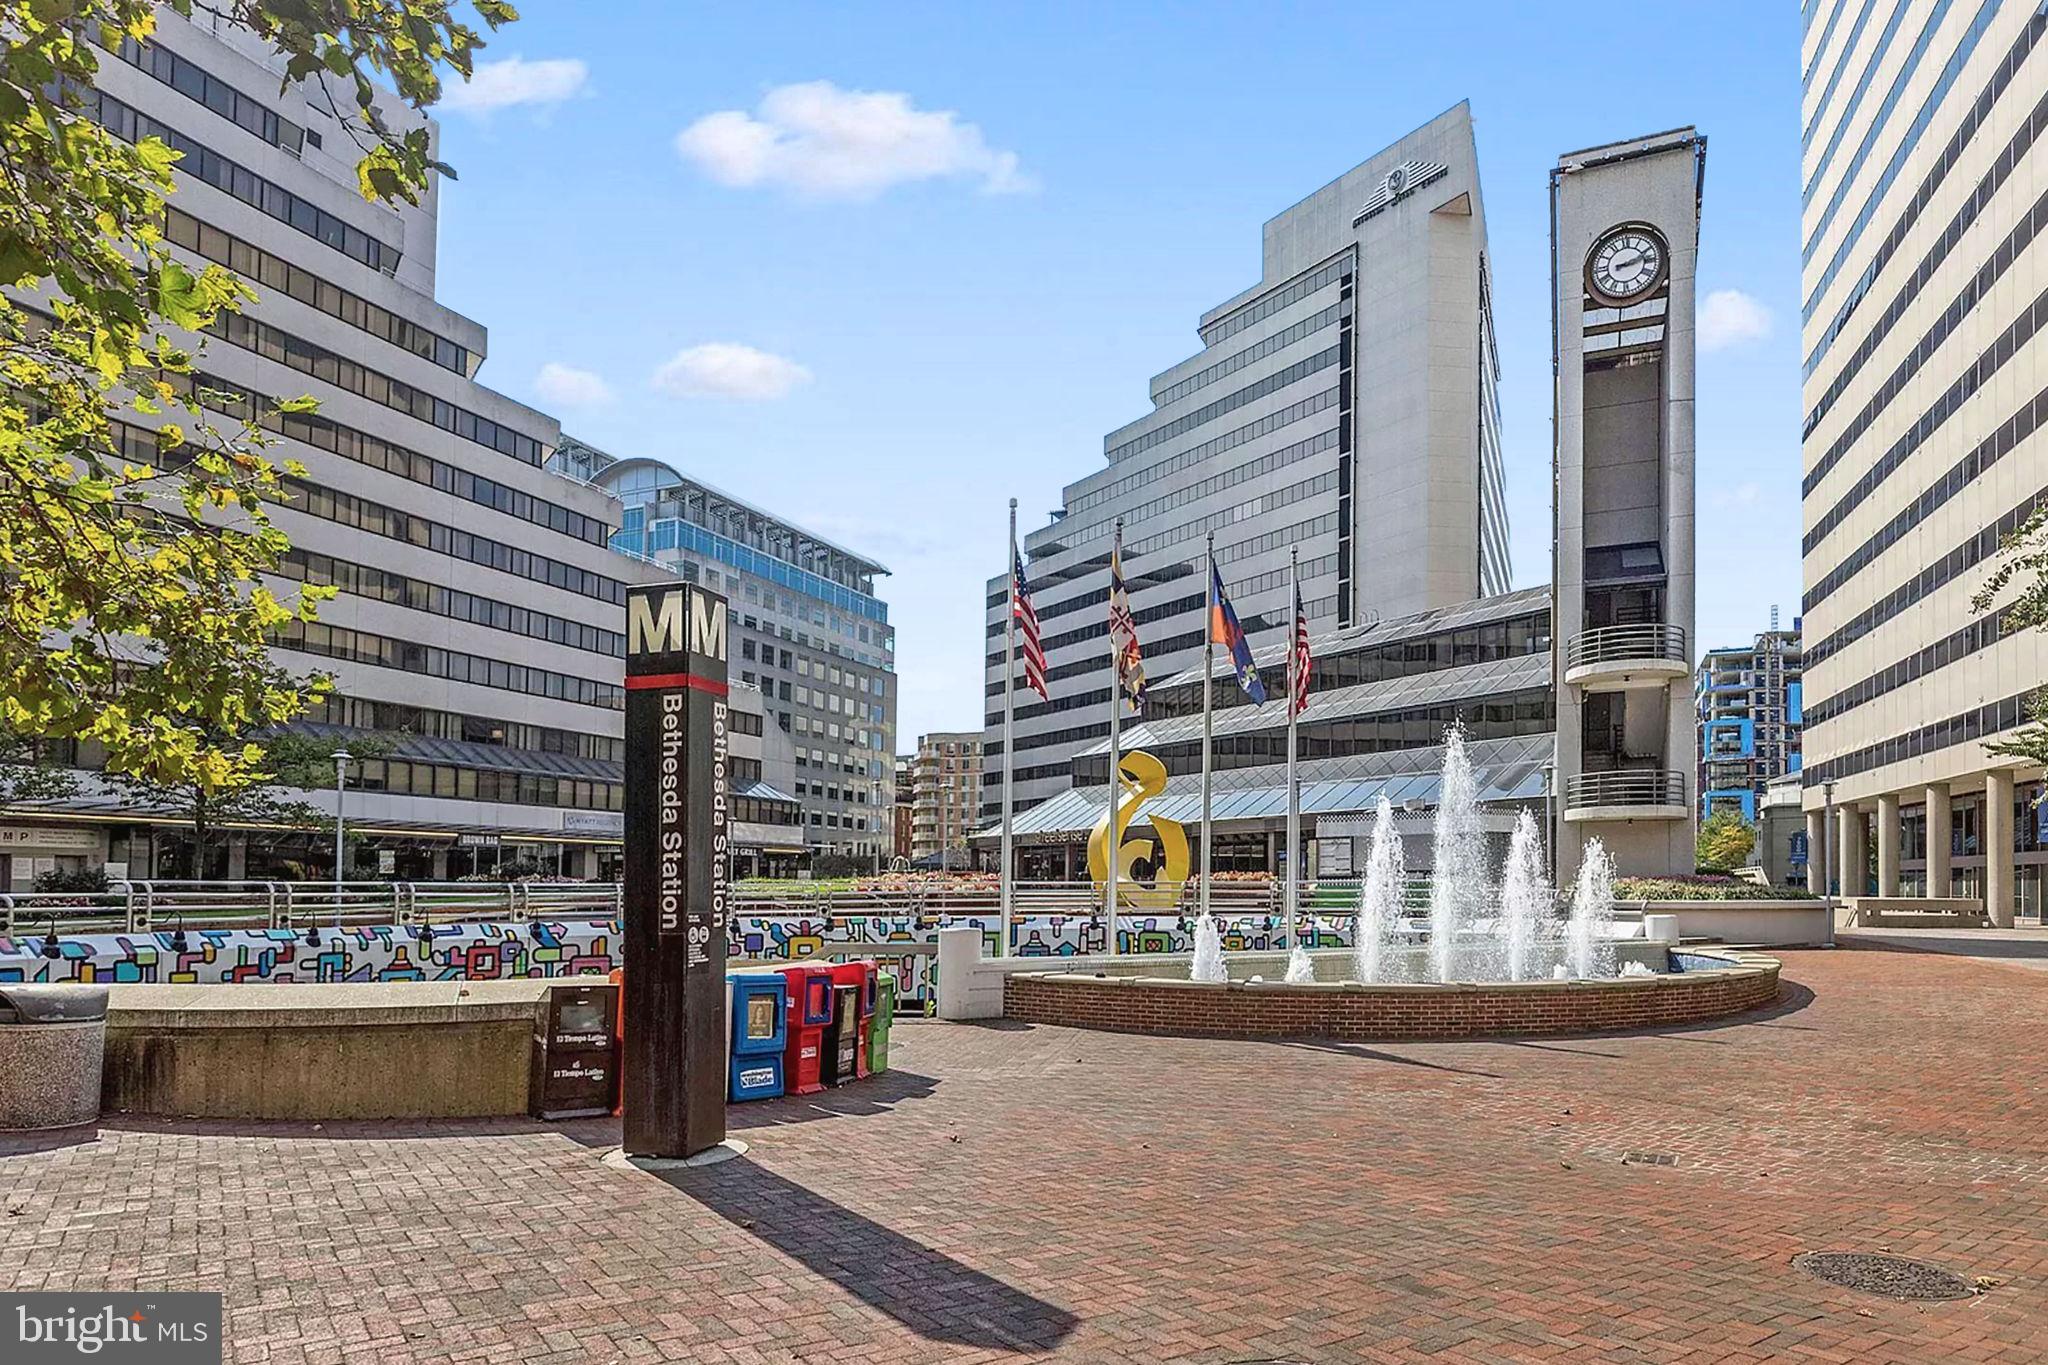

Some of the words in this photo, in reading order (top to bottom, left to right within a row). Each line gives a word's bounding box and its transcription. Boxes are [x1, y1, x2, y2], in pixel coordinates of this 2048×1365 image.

[629, 590, 682, 655] M
[691, 590, 726, 662] M
[662, 694, 683, 824] Bethesda
[714, 702, 728, 826] Bethesda
[662, 832, 683, 930] Station
[713, 835, 727, 928] Station
[561, 1069, 584, 1079] Tiempo
[564, 1034, 587, 1044] Tiempo
